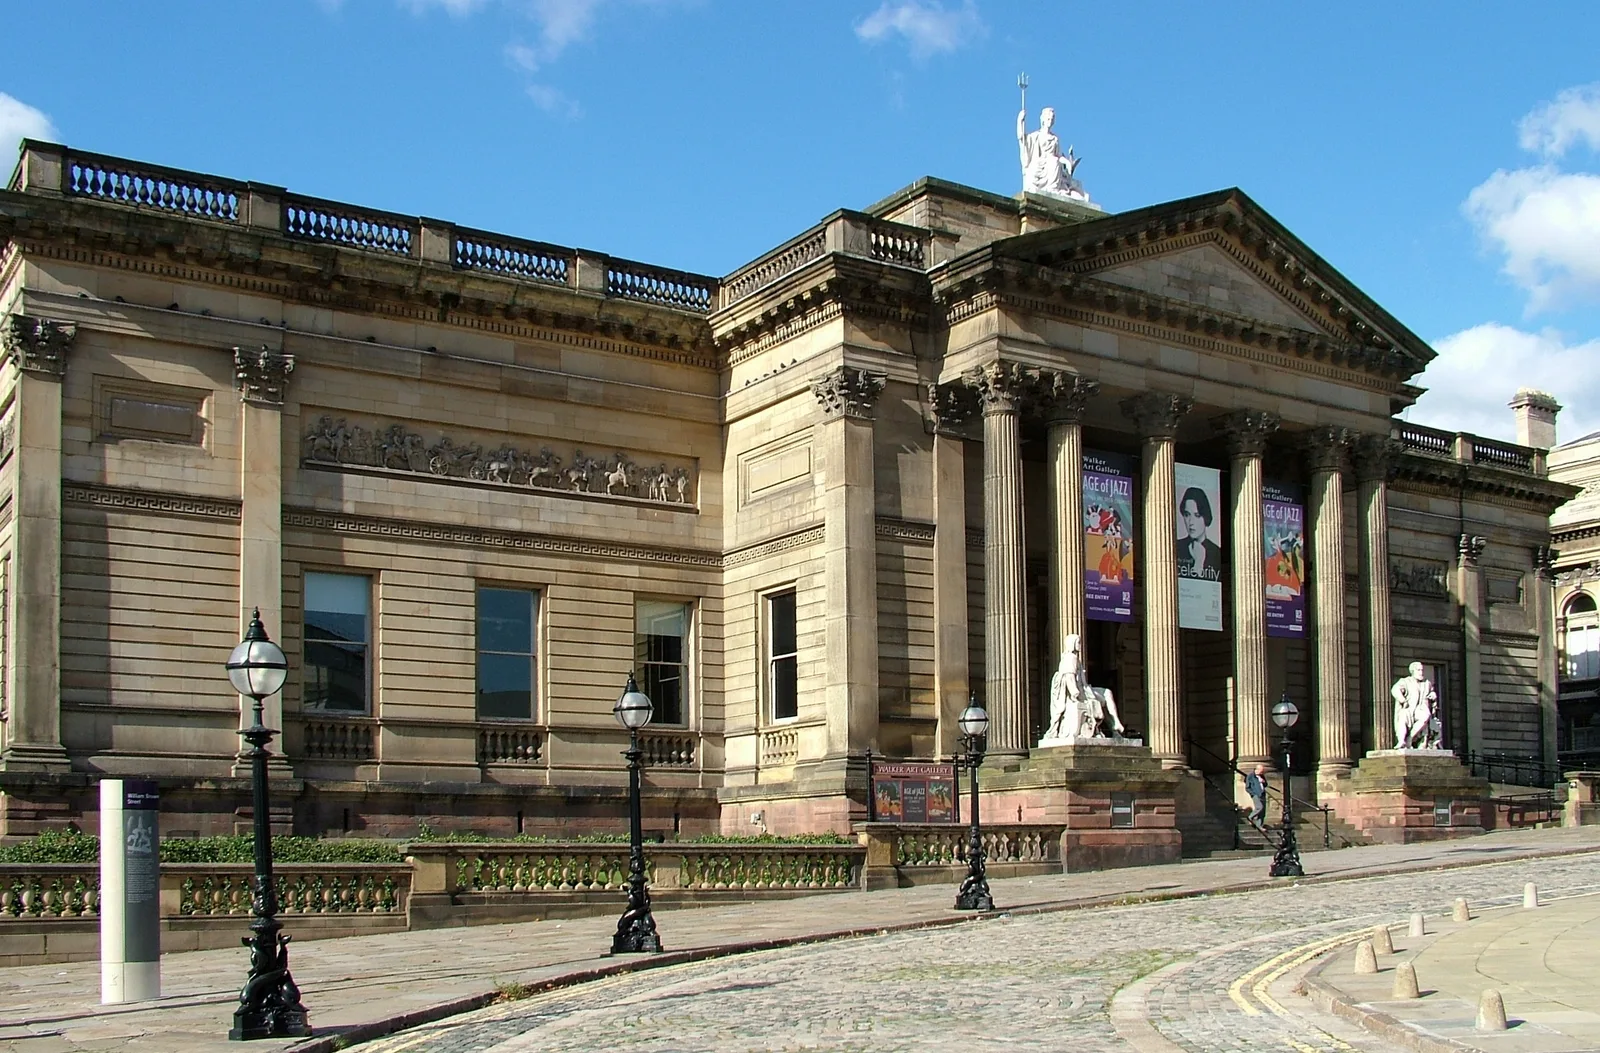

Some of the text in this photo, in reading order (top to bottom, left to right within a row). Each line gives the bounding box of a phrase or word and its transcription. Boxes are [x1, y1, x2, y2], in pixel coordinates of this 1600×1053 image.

[1083, 455, 1106, 465] Walker
[1095, 465, 1120, 475] Gallery
[1083, 475, 1128, 498] AGE of JAZZ
[1271, 494, 1293, 503] Gallery
[1276, 506, 1283, 520] of
[1283, 507, 1300, 523] JAZZ
[878, 765, 904, 773] WALKER
